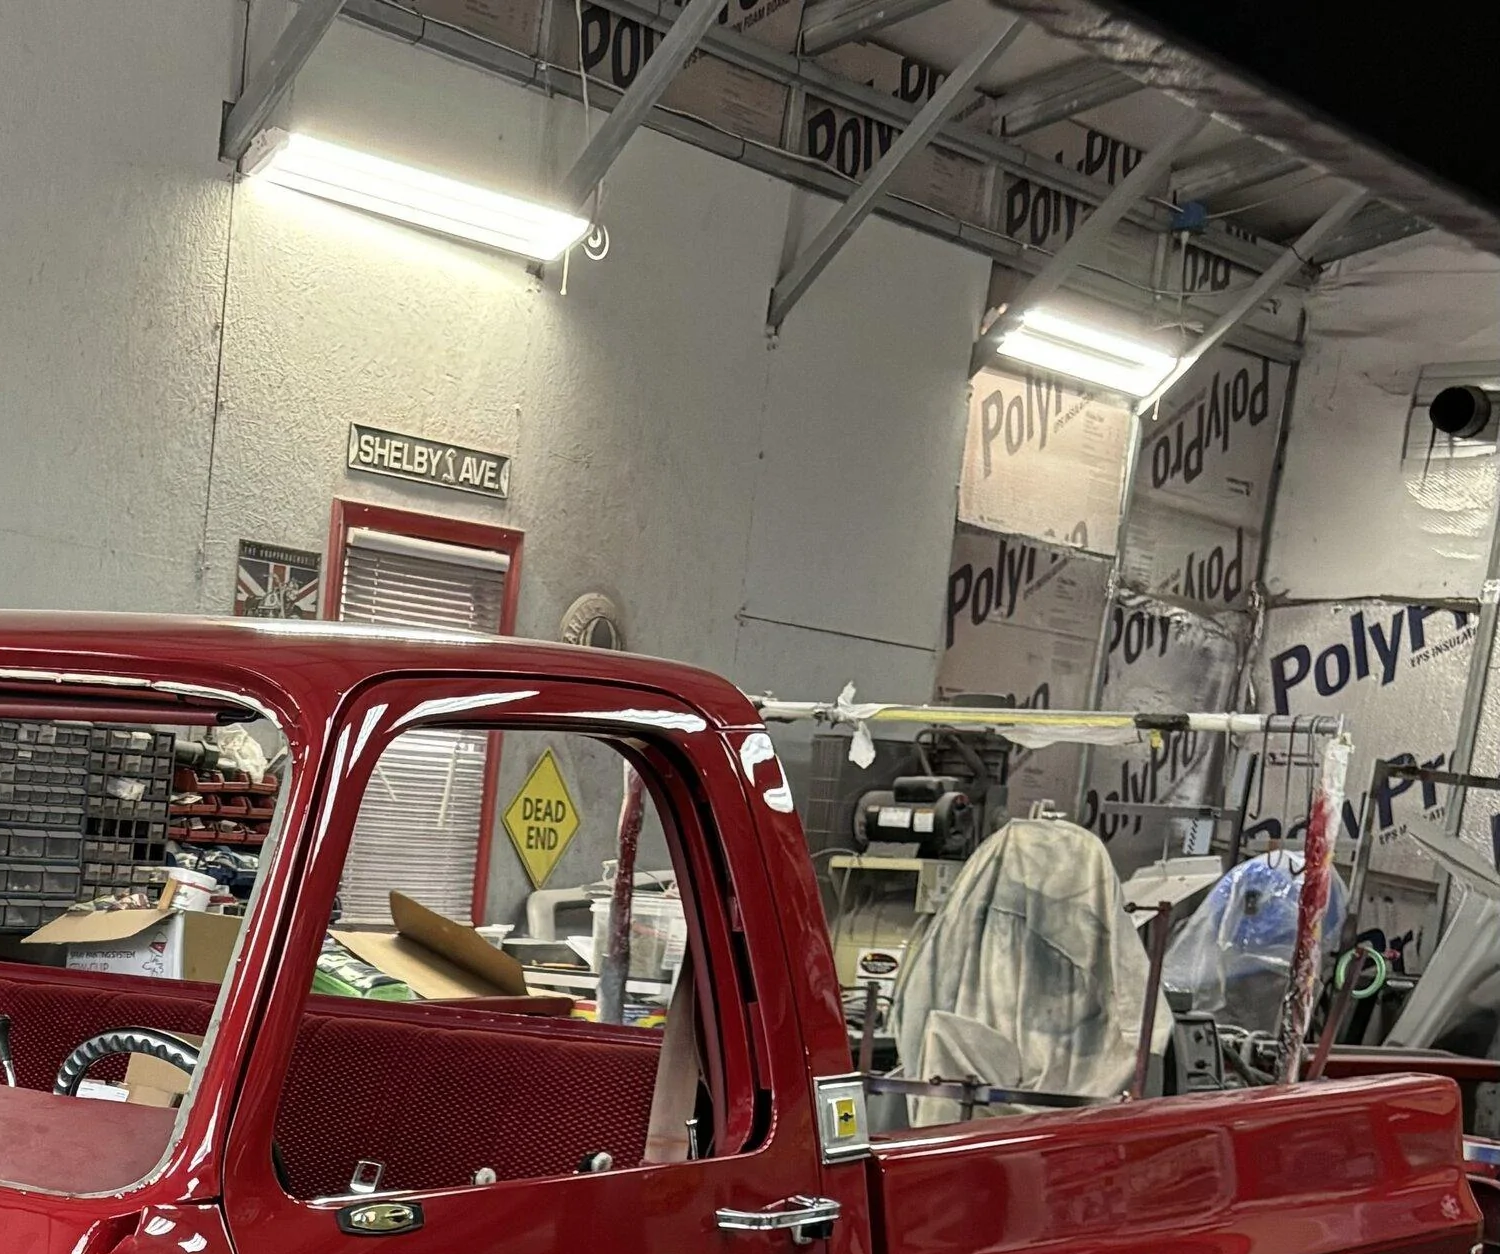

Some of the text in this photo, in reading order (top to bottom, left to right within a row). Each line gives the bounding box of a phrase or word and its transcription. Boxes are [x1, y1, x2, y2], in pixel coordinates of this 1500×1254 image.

[1152, 358, 1269, 489] PolyPro
[358, 434, 499, 489] SHELBY AVE.
[1175, 527, 1242, 602] Poly
[522, 797, 567, 824] DEAD
[525, 826, 559, 851] END
